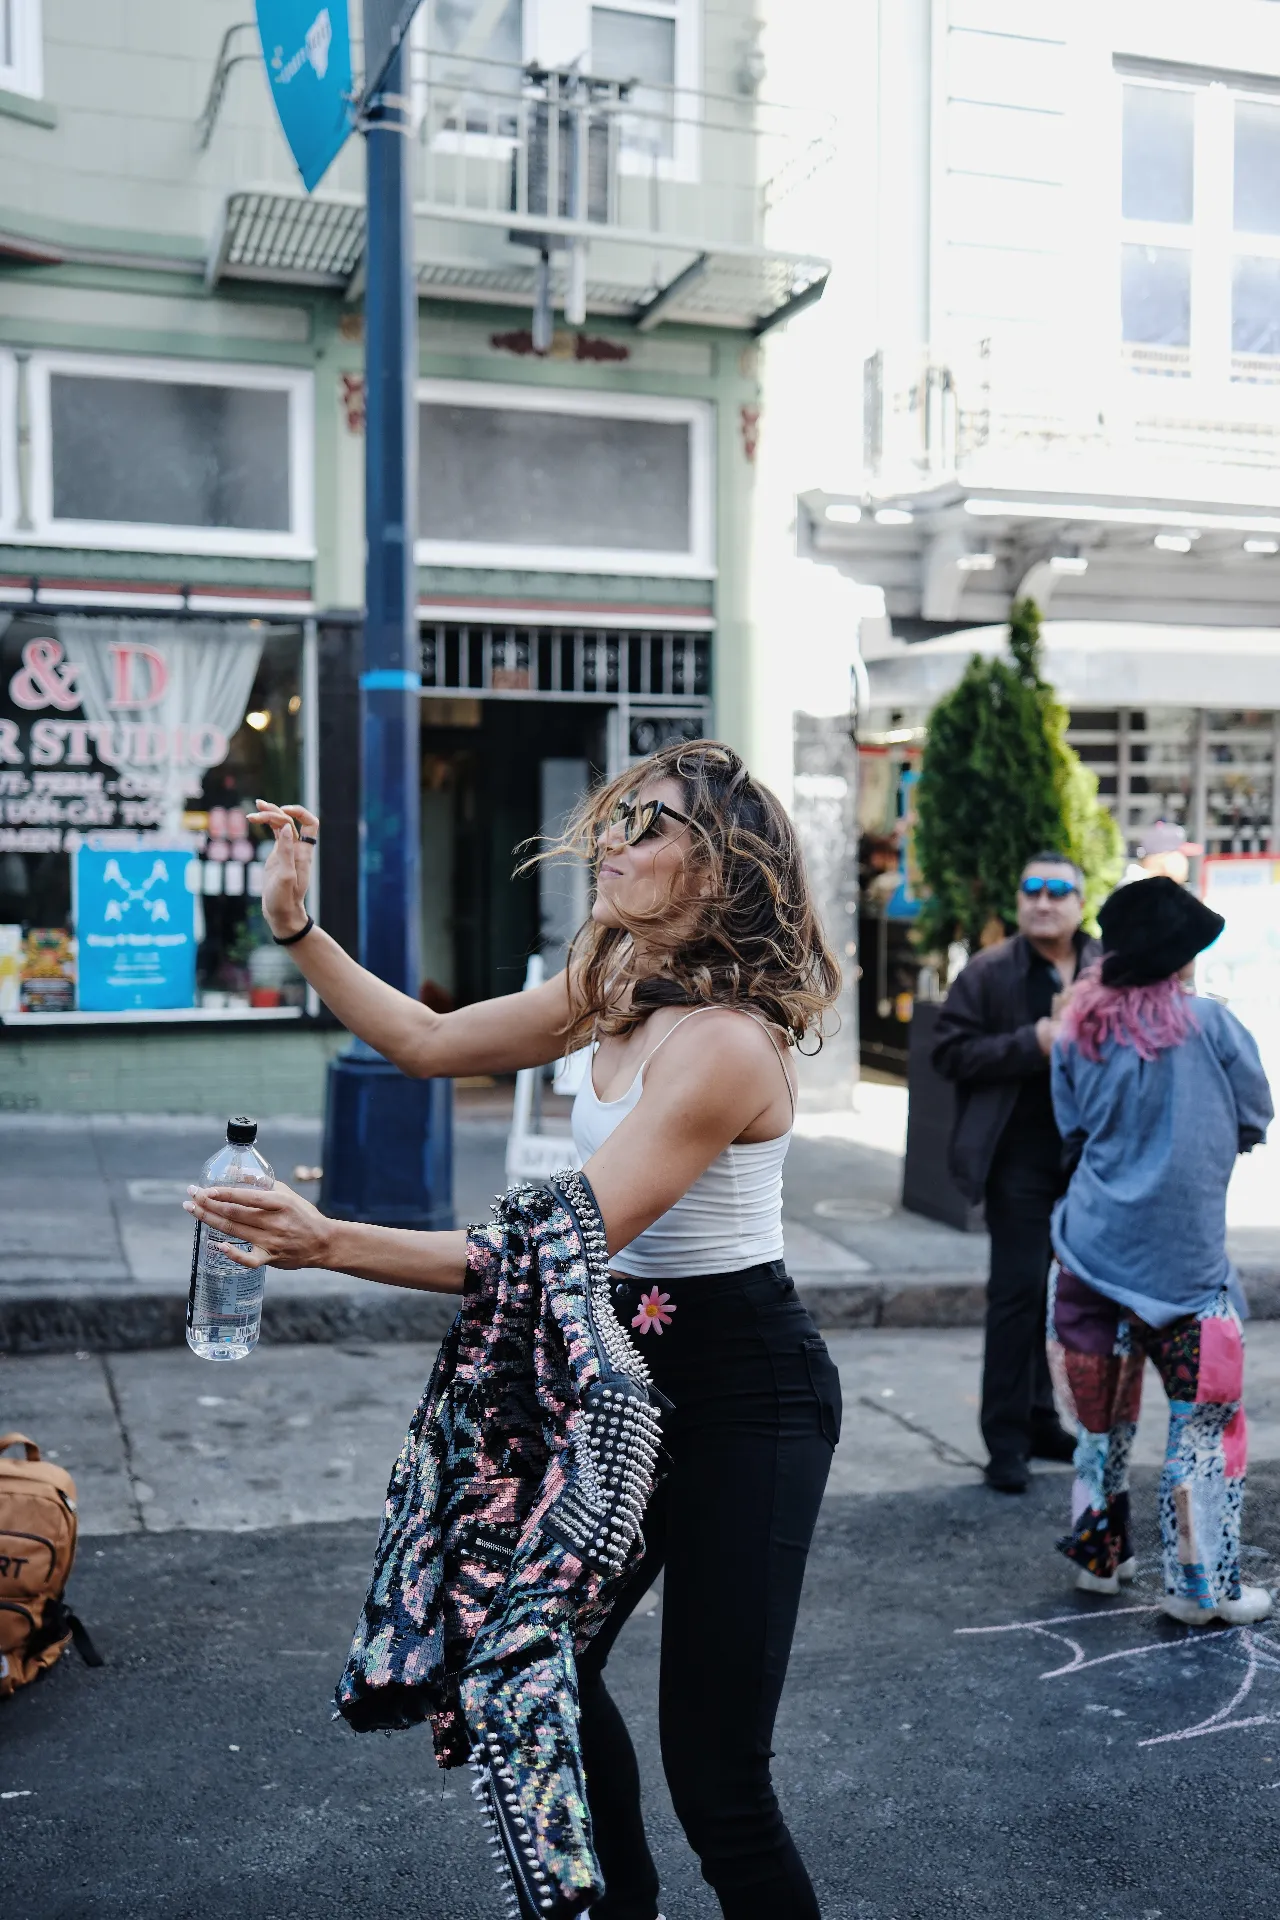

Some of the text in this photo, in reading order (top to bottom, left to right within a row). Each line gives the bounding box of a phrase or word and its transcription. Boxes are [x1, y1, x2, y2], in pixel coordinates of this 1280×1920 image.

[9, 637, 170, 711] & D
[29, 718, 230, 767] STUDIO
